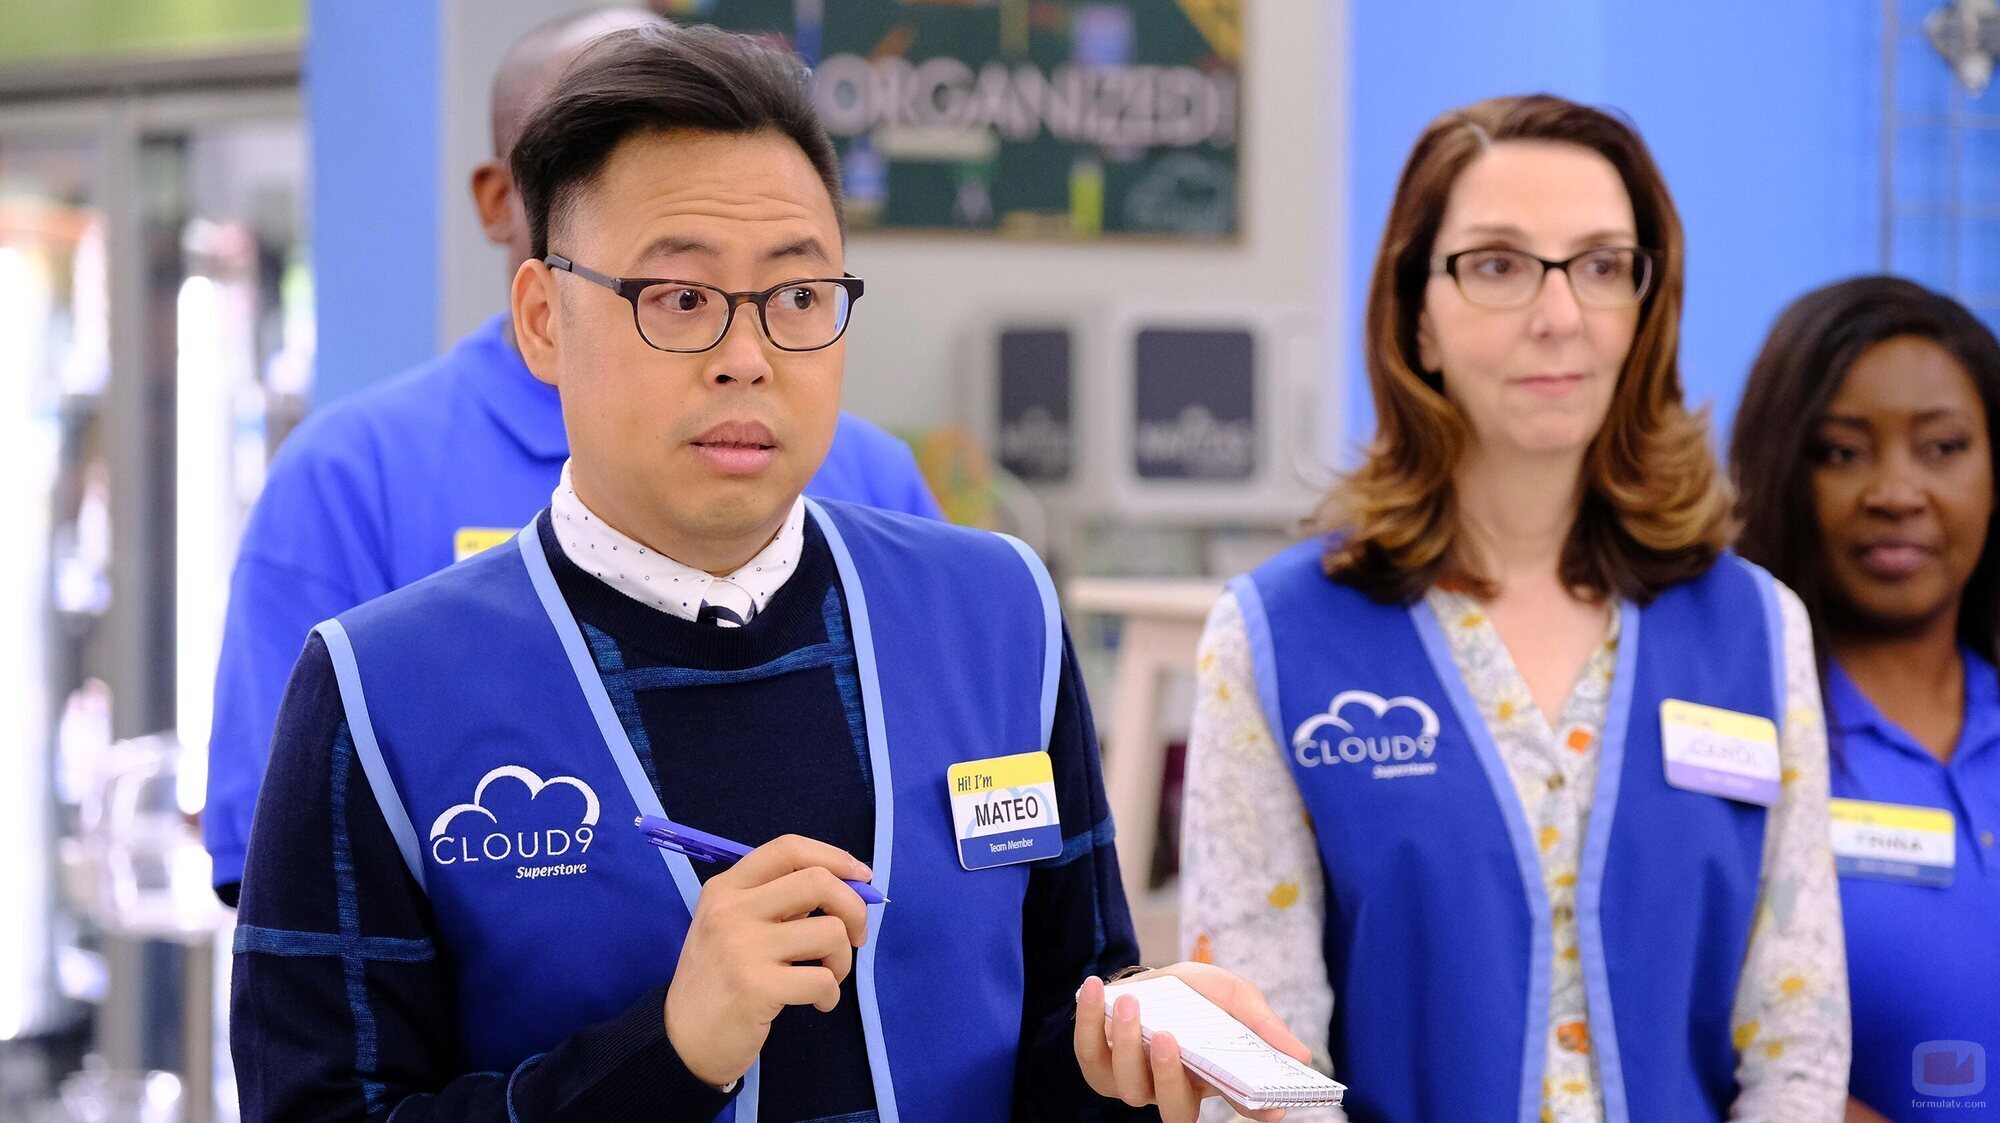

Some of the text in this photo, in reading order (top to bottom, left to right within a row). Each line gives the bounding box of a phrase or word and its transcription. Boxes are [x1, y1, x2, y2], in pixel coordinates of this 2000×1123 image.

[1295, 735, 1437, 768] CLOUD9
[957, 773, 993, 792] Hi! I'm
[975, 795, 1039, 827] MATEO
[432, 827, 594, 865] CLOUD9
[989, 838, 1034, 853] Team Member
[515, 862, 588, 880] Superstore
